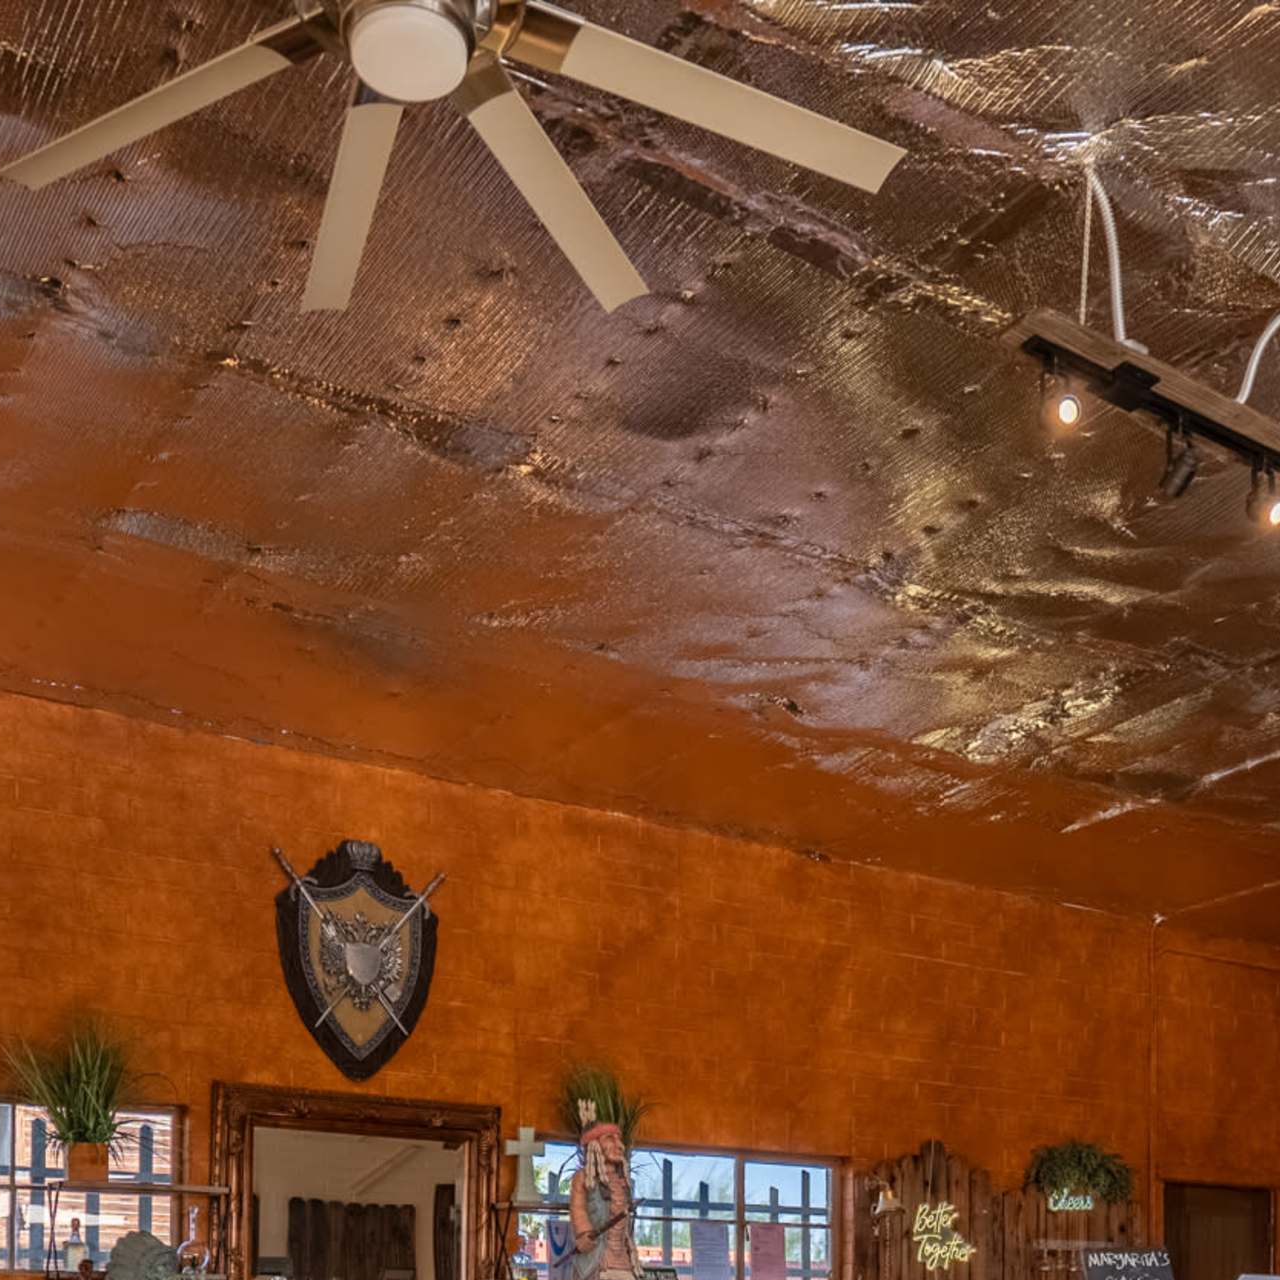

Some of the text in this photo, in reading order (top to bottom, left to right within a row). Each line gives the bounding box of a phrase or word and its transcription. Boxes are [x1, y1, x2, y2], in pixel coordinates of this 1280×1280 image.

[1048, 1187, 1093, 1211] Cheers
[913, 1201, 959, 1232] Better
[913, 1232, 977, 1270] Together
